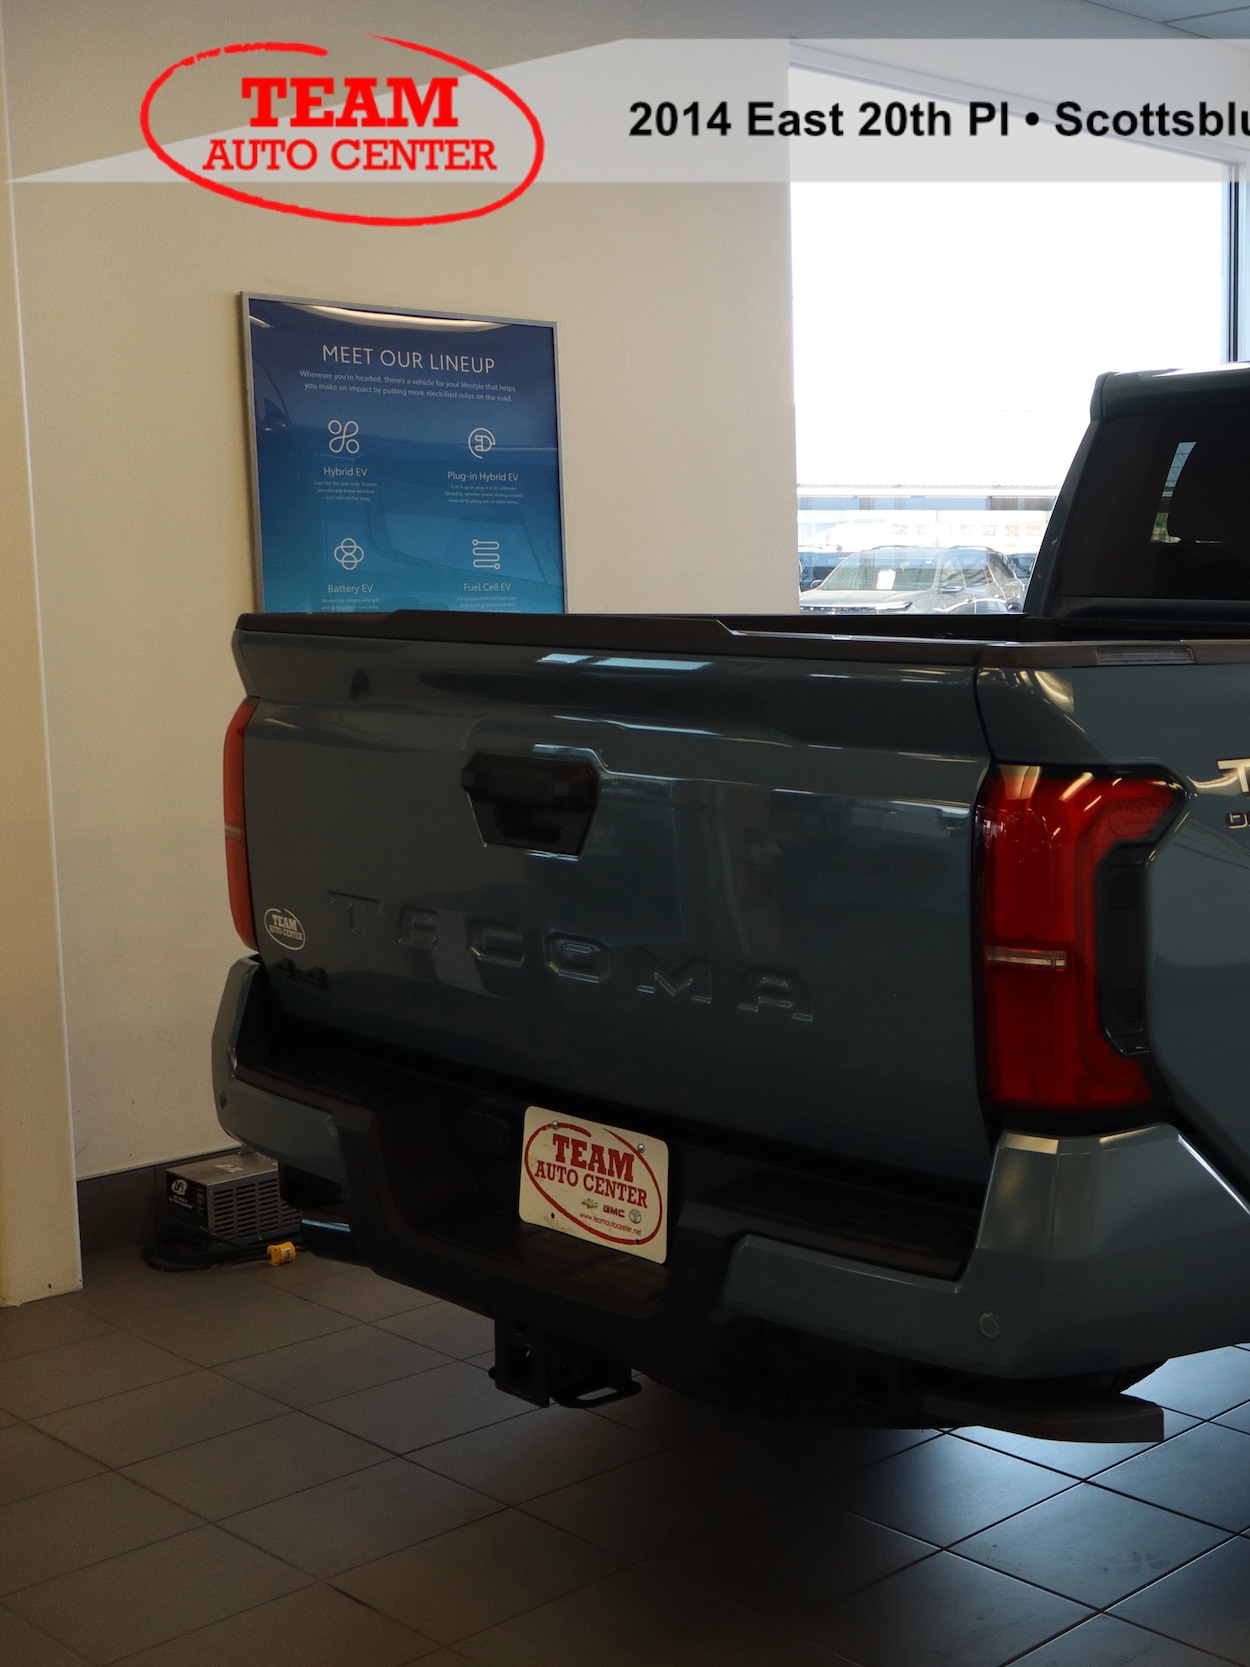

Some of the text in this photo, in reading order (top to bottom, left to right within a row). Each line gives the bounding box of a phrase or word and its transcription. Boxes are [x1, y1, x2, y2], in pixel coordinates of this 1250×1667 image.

[322, 345, 495, 374] MEET OUR LINEUP
[299, 370, 333, 379] Wherever
[446, 381, 460, 389] your
[460, 381, 485, 391] lifestyle
[499, 385, 516, 393] helps
[319, 383, 338, 391] make
[349, 385, 372, 394] impact
[373, 386, 382, 394] by
[383, 387, 407, 397] putting
[426, 390, 457, 398] electrified
[458, 392, 475, 400] miles
[323, 467, 368, 478] Hybrid EV
[447, 471, 519, 482] Plug-in Hybrid EV
[327, 584, 373, 595] Battery EV
[463, 583, 511, 592] Fuel Cell EV
[272, 914, 298, 931] TEAM
[327, 890, 815, 1022] TACOMA
[552, 1133, 635, 1183] TEAM
[535, 1160, 648, 1209] AUTO CENTER
[603, 1205, 626, 1218] GMC
